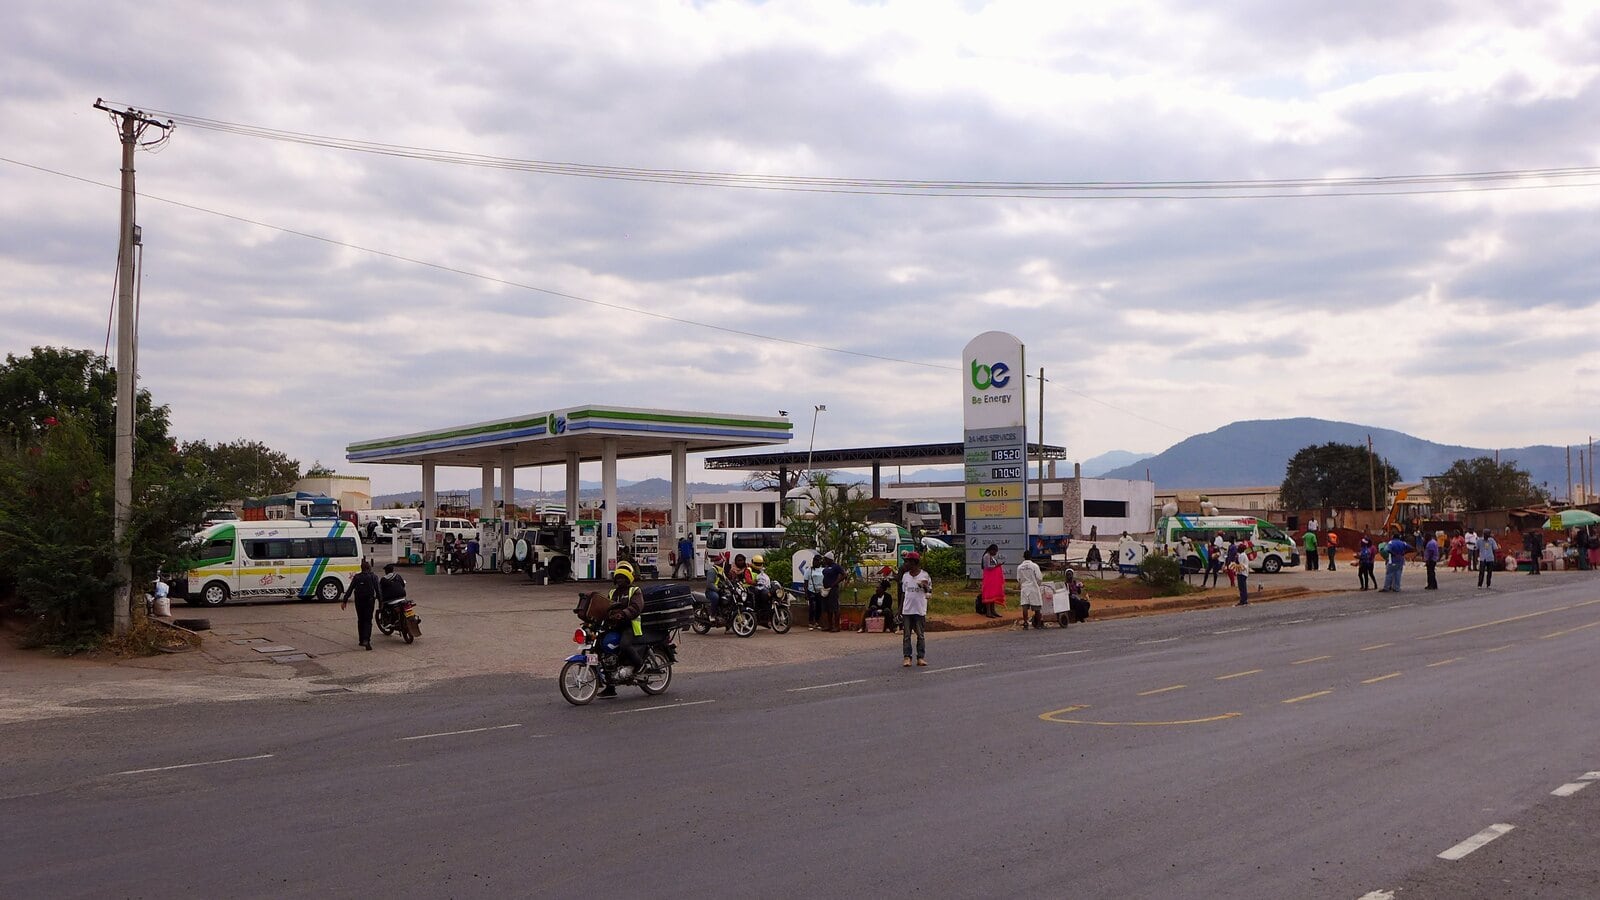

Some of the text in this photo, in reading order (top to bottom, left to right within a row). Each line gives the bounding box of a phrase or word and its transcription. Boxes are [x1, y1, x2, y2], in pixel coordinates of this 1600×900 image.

[971, 358, 1010, 390] be
[971, 394, 1012, 405] Be Energy
[549, 413, 566, 435] be
[968, 435, 976, 443] 24
[989, 432, 1017, 441] SERVICES
